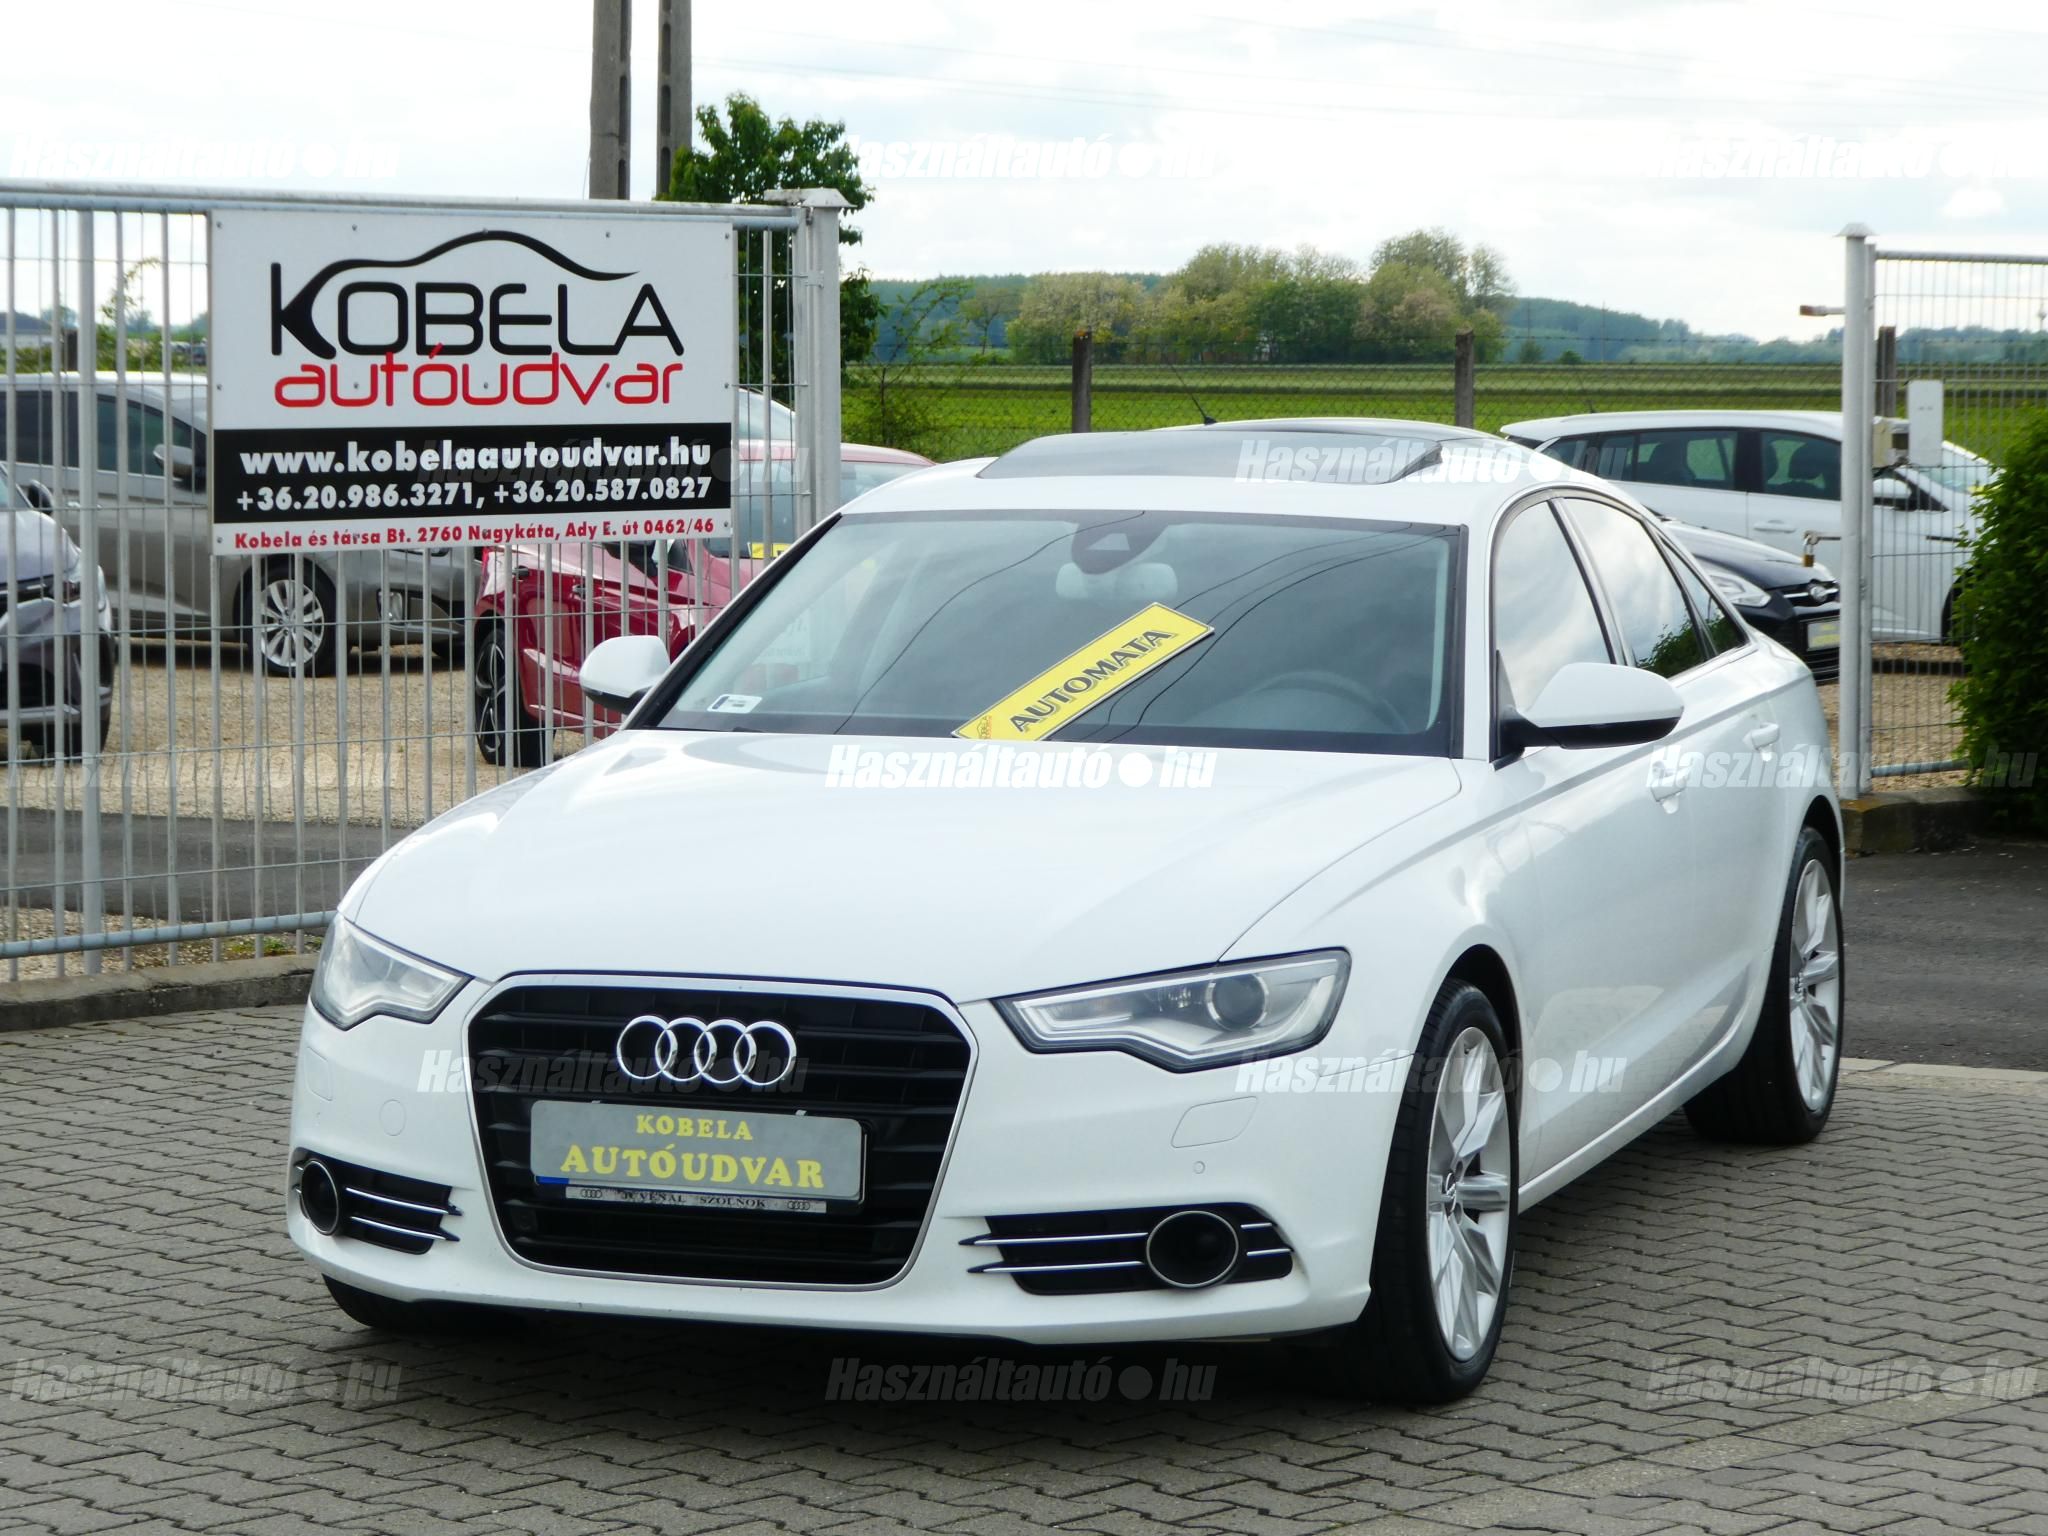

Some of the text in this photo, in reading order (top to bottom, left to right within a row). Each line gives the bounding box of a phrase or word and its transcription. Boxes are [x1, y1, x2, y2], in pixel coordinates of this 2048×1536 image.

[271, 262, 685, 359] KOBELA
[275, 343, 683, 407] autóudvar
[239, 436, 711, 475] www.kobelaautoudvar.hu
[237, 476, 712, 511] +36.20.986.3271, +36.20.587.0827
[235, 517, 715, 549] Kobela és társa Bt. 2760 Nagykáta, Ady E. út 0462/46
[1009, 629, 1174, 733] AUTOMATA
[636, 1114, 753, 1141] KOBELA
[560, 1143, 824, 1189] AUTÓUDVAR
